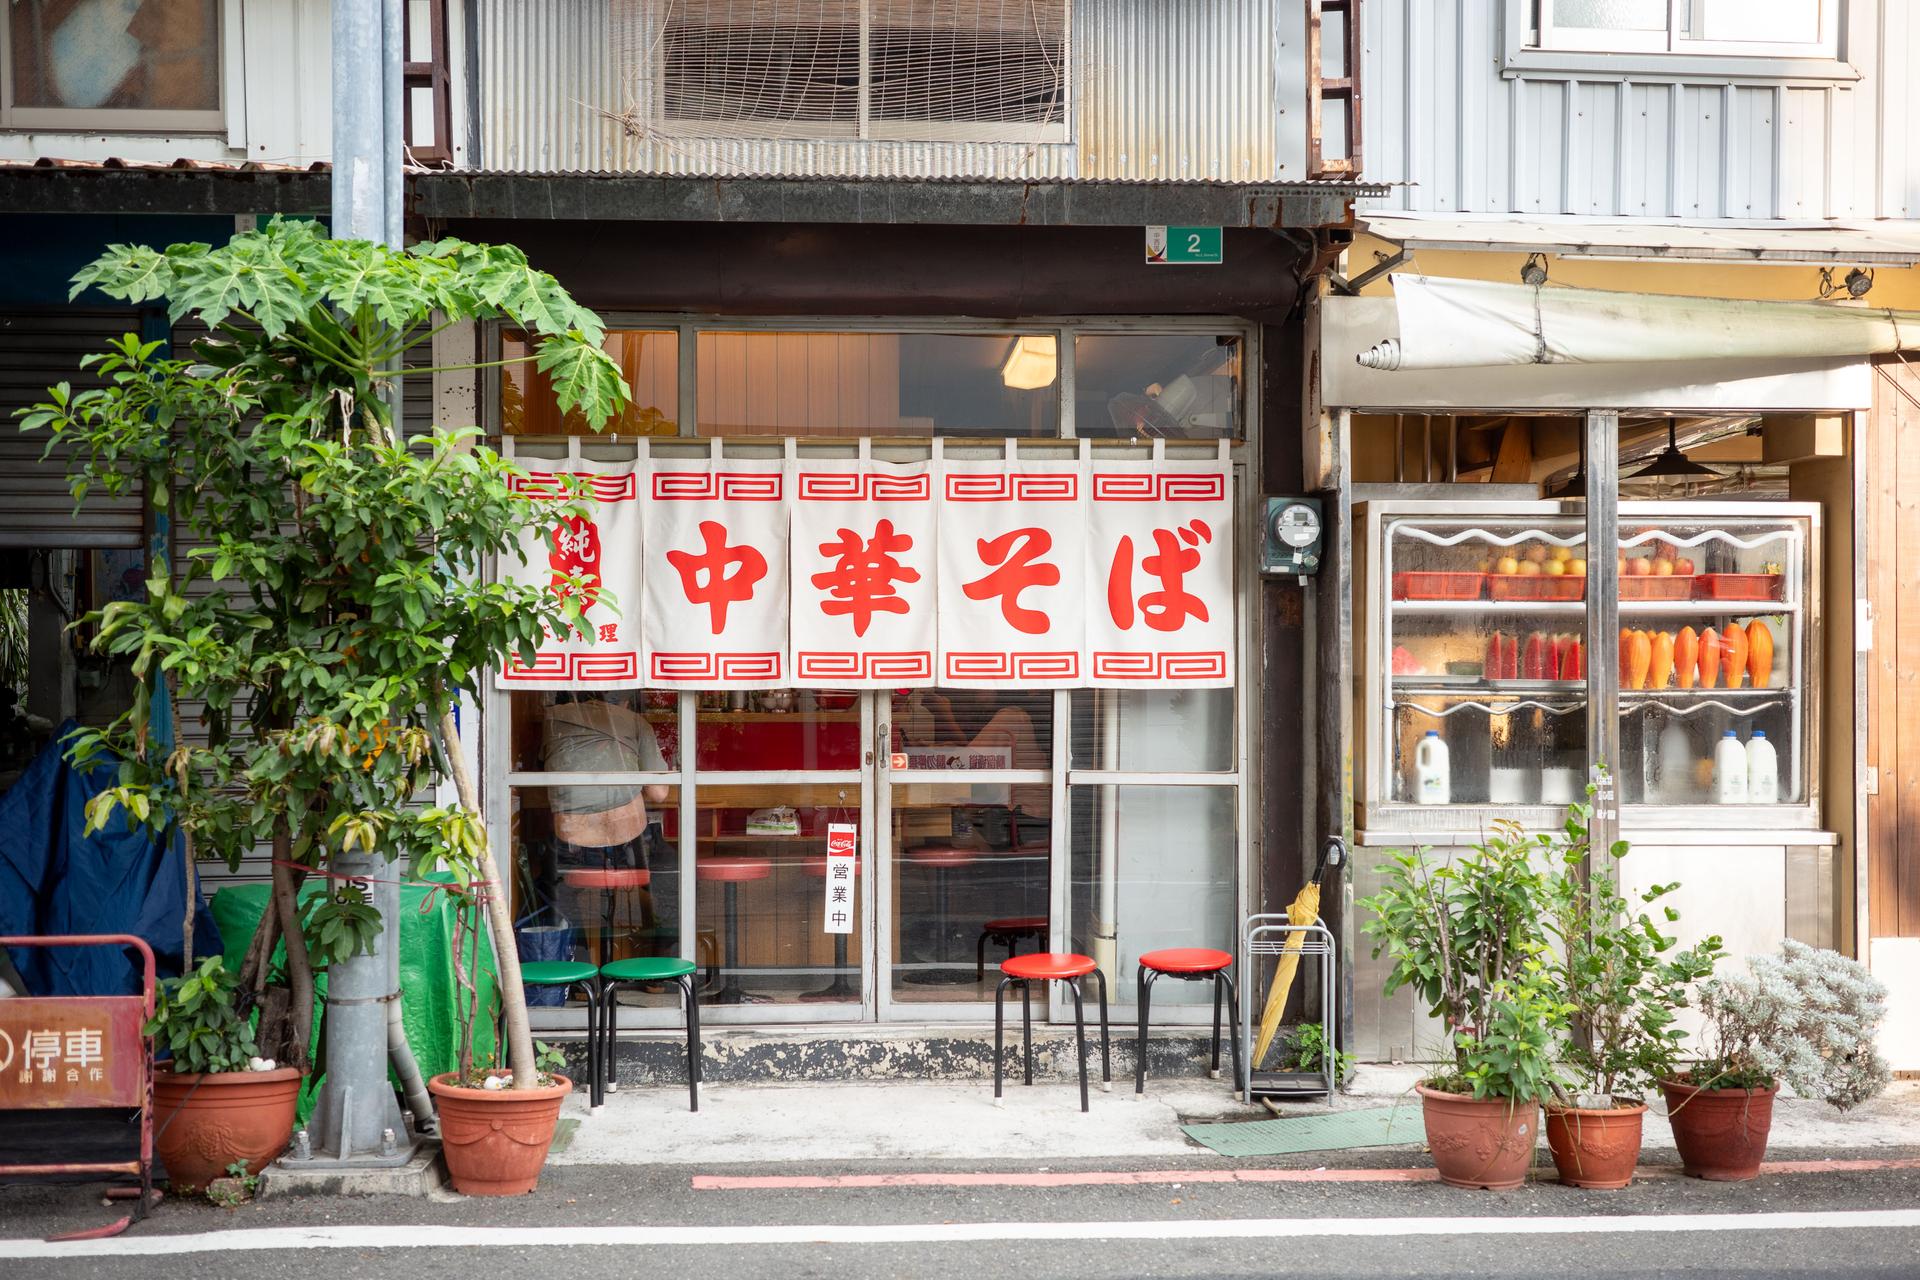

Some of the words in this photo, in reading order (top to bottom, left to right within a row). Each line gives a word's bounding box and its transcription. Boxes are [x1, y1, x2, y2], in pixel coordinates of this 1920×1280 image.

[1188, 234, 1201, 253] 2
[666, 519, 1213, 638] 中華そば
[832, 863, 848, 926] 営業中
[22, 1028, 103, 1069] 停車
[19, 1068, 103, 1083] 謝謝合作
